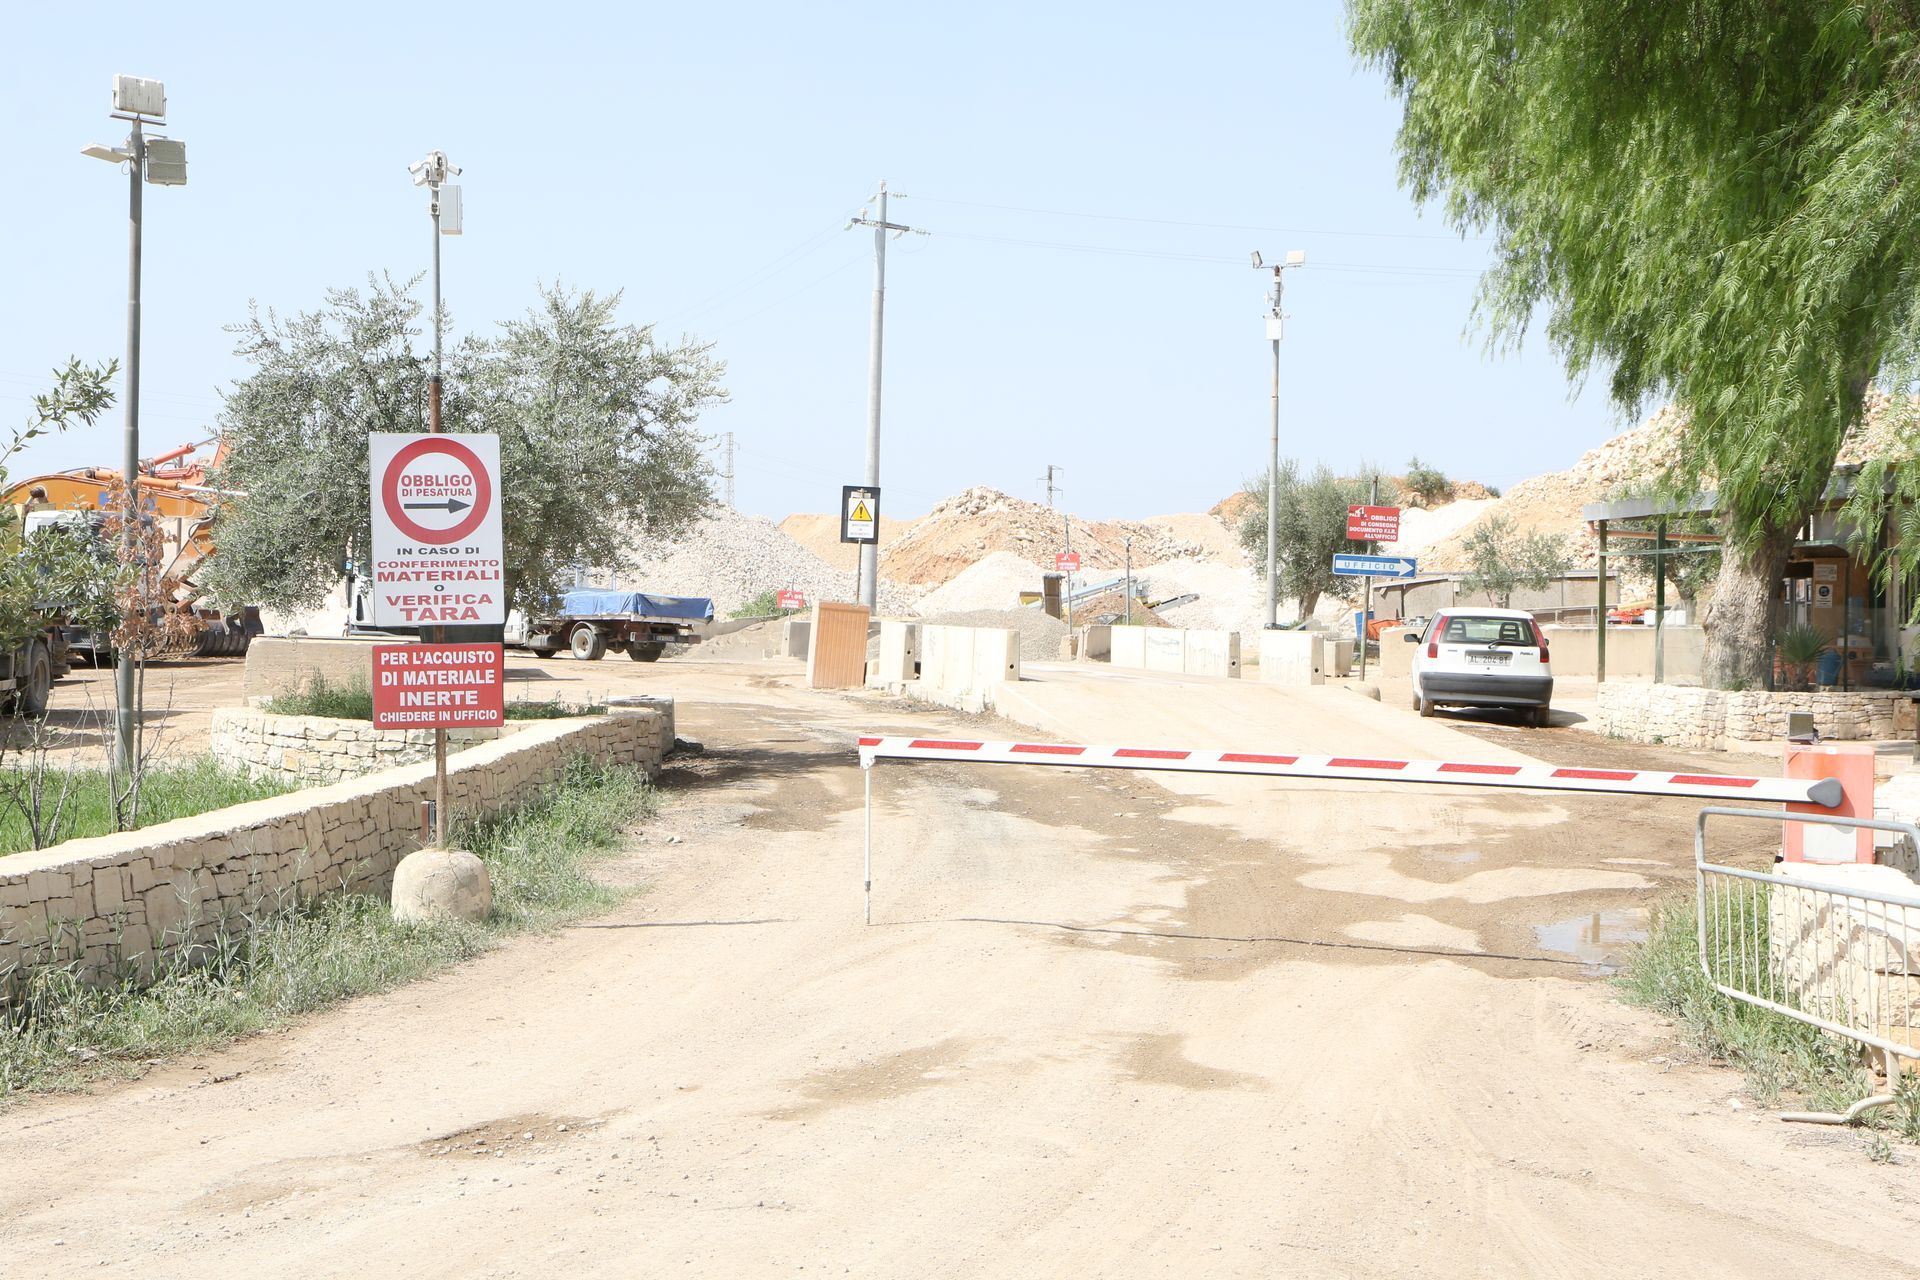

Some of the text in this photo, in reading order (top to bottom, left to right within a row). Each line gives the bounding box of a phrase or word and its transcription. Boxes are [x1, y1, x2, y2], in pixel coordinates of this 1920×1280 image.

[401, 474, 472, 487] OBBLIGO
[402, 488, 472, 497] DI PESATURA
[397, 546, 480, 555] IN CASO DI
[377, 559, 500, 569] CONFERIMENTO
[1344, 561, 1395, 570] UFFICIO
[377, 570, 500, 582] MATERIALI
[433, 584, 445, 592] O
[385, 593, 493, 606] VERIFICA
[400, 606, 480, 621] TARA
[380, 650, 495, 665] PER L'ACQUISTO
[381, 669, 495, 686] DI MATERIALE
[399, 690, 479, 707] INERTE
[380, 709, 498, 722] CHIEDERE IN UFFICIO
